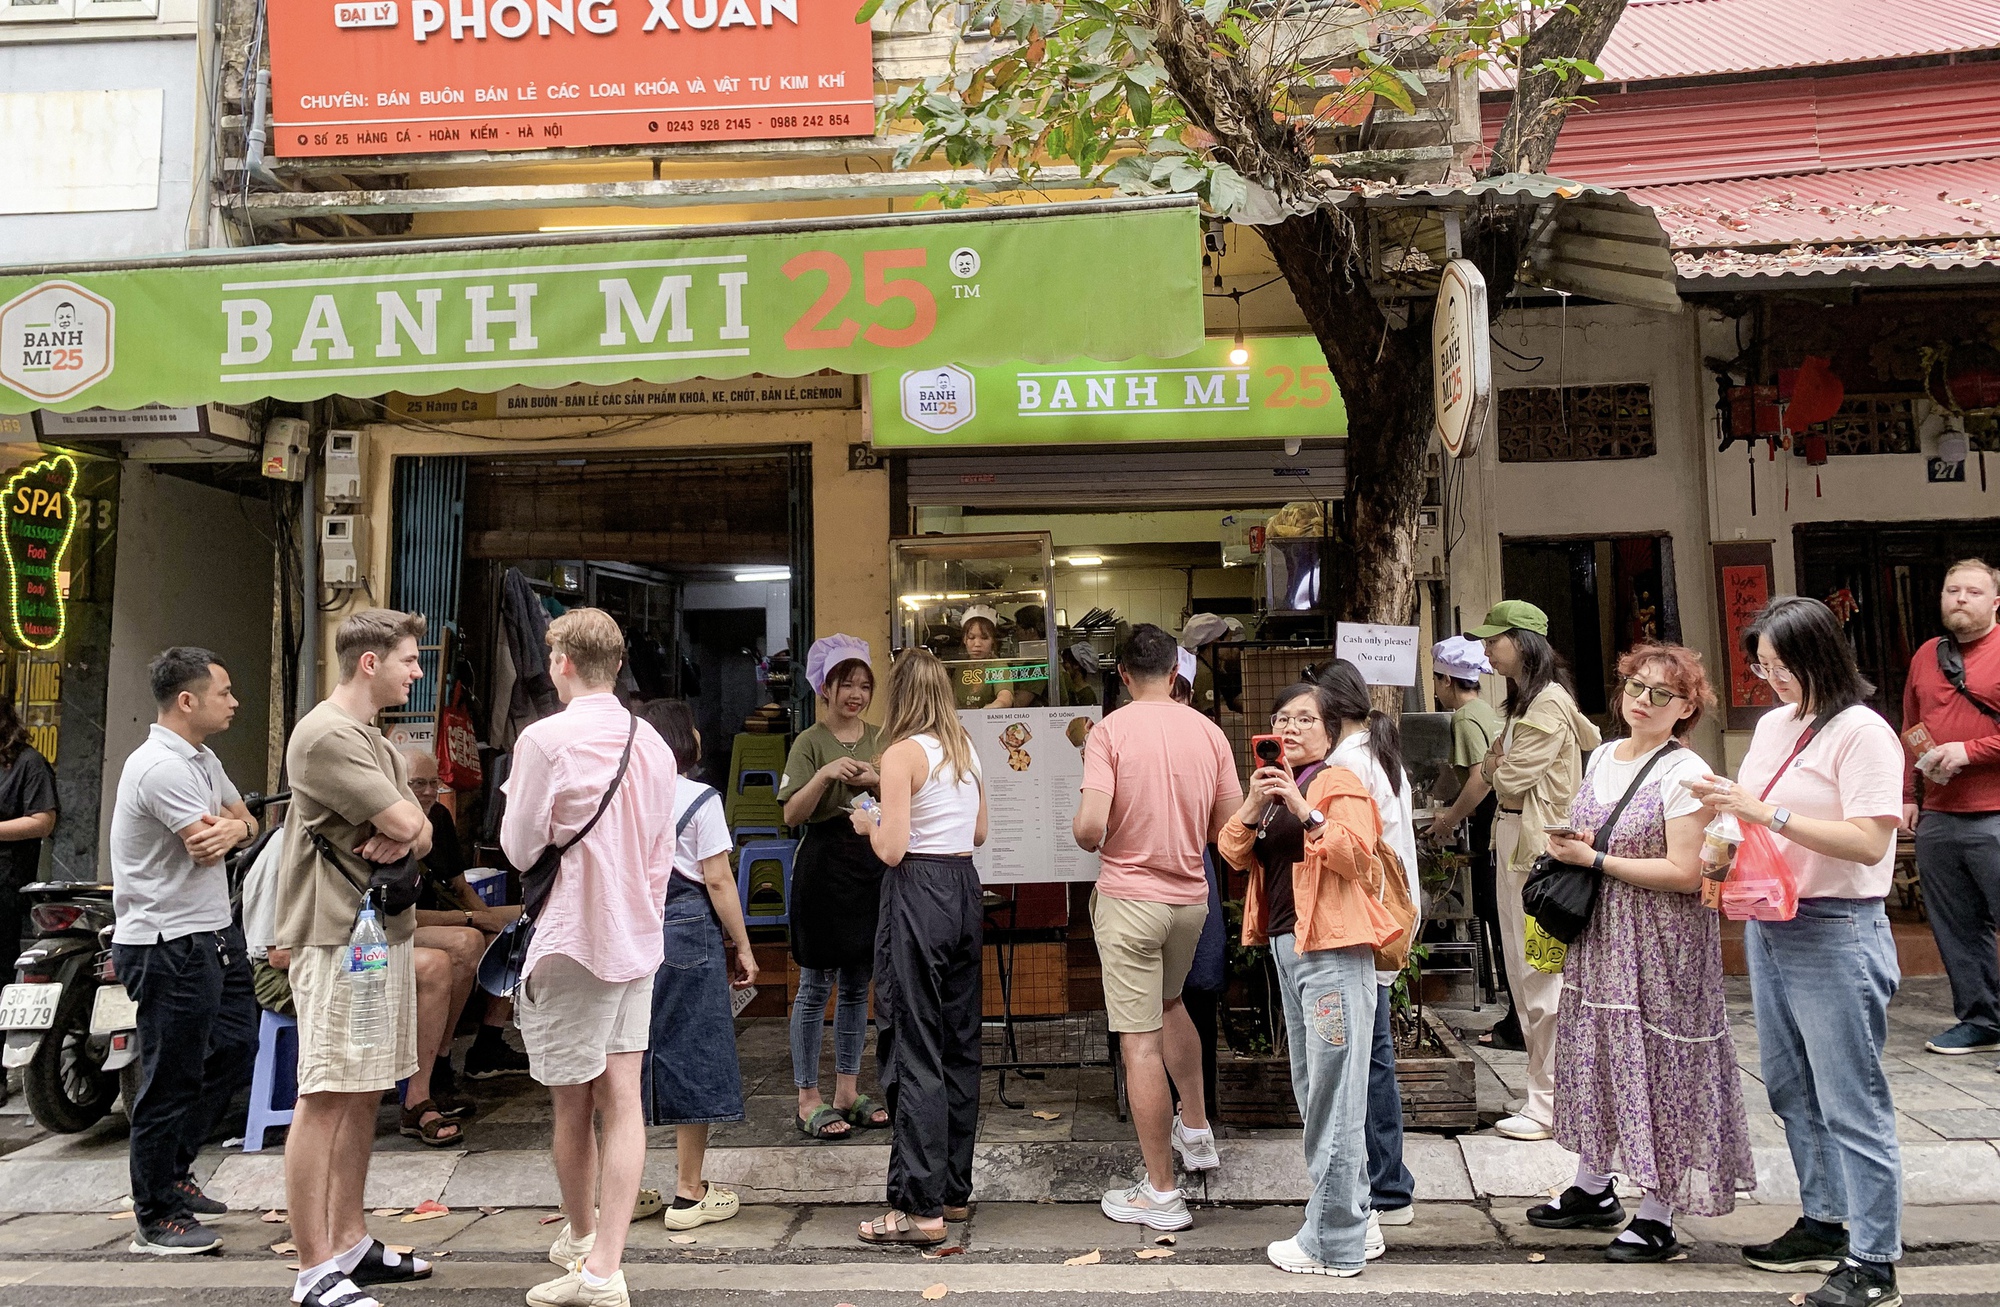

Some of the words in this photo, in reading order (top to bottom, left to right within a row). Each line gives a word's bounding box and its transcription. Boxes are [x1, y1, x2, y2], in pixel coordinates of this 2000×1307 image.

[340, 8, 366, 24] ĐẠI
[374, 4, 391, 21] LÝ
[412, 0, 618, 41] PHONG
[300, 91, 369, 109] CHUYÊN:
[377, 90, 410, 107] BÁN
[420, 87, 464, 105] BUÔN
[475, 85, 508, 102] BÁN
[517, 82, 537, 100] LẺ
[547, 82, 580, 99] CÁC
[635, 78, 679, 96] KHÓA
[686, 77, 706, 93] VÀ
[713, 76, 740, 95] VẬT
[749, 76, 771, 91] TƯ
[780, 76, 808, 90] KIM
[818, 71, 845, 88] KHÍ
[667, 120, 694, 132] 0243
[700, 119, 720, 131] 928
[726, 118, 751, 130] 2145
[770, 117, 797, 129] 0988
[803, 115, 823, 127] 242
[829, 114, 850, 126] 854
[336, 133, 349, 145] 25
[357, 130, 387, 144] HÀNG
[396, 129, 411, 142] CÁ
[429, 126, 460, 141] HOÀN
[470, 124, 498, 140] KIẾM
[518, 127, 534, 138] HÀ
[544, 125, 563, 139] NỘI
[952, 283, 981, 299] TM
[220, 282, 538, 366] BANH
[599, 272, 750, 346] MI
[780, 247, 937, 350] 25
[24, 330, 83, 347] BANH
[1440, 337, 1461, 376] BANH
[508, 397, 528, 409] BÁN
[531, 395, 557, 408] BUÔN
[565, 394, 586, 407] BÁN
[602, 392, 621, 406] CÁC
[625, 389, 644, 404] SẢN
[762, 384, 781, 400] BẢN
[800, 386, 842, 400] CRÊMON
[919, 390, 956, 400] BANH
[1017, 376, 1158, 410] BANH
[1184, 374, 1249, 405] MI
[1264, 365, 1333, 408] 25
[407, 401, 422, 413] 25
[855, 448, 877, 466] 25
[1935, 461, 1958, 479] 27
[13, 487, 62, 519] SPA
[77, 499, 112, 529] 23
[27, 543, 47, 559] Foot
[27, 581, 46, 597] Body
[1343, 634, 1362, 644] Cash
[1365, 637, 1382, 646] only
[1384, 637, 1411, 647] please!
[1357, 652, 1372, 663] (No
[1374, 654, 1396, 663] card)
[0, 1007, 52, 1026] 013.79
